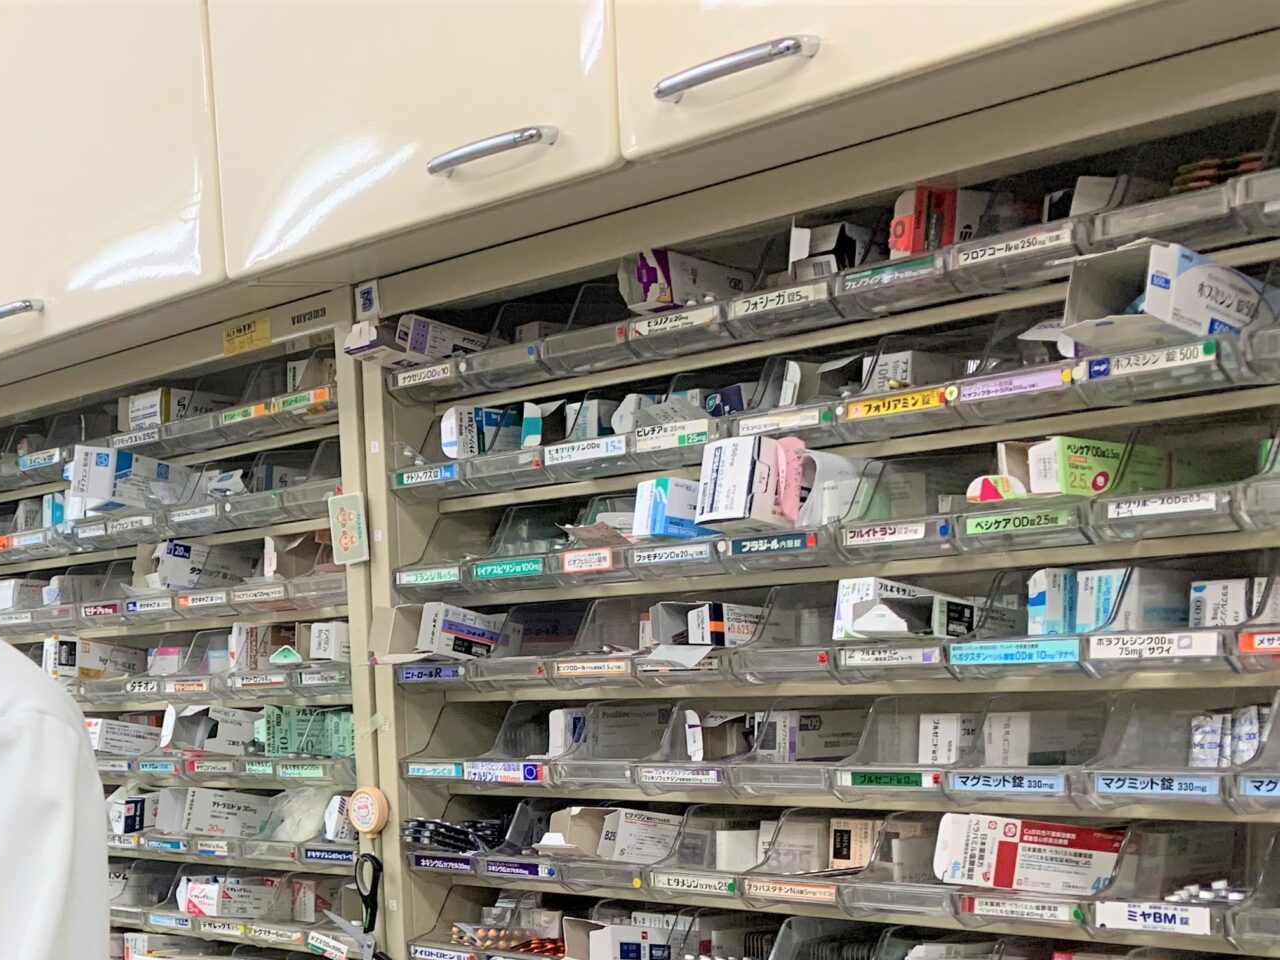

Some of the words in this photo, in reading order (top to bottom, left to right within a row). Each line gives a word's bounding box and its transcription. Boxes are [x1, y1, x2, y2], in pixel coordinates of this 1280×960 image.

[361, 288, 373, 312] 3
[1111, 350, 1162, 371] ホスミシン
[1119, 647, 1143, 657] 75mg
[959, 775, 1024, 789] マグミット錠
[1027, 779, 1055, 790] 330mg
[1102, 776, 1174, 790] マグミット錠
[1177, 780, 1207, 792] 330mg
[604, 830, 616, 841] B25
[1127, 910, 1177, 925] ミヤBM
